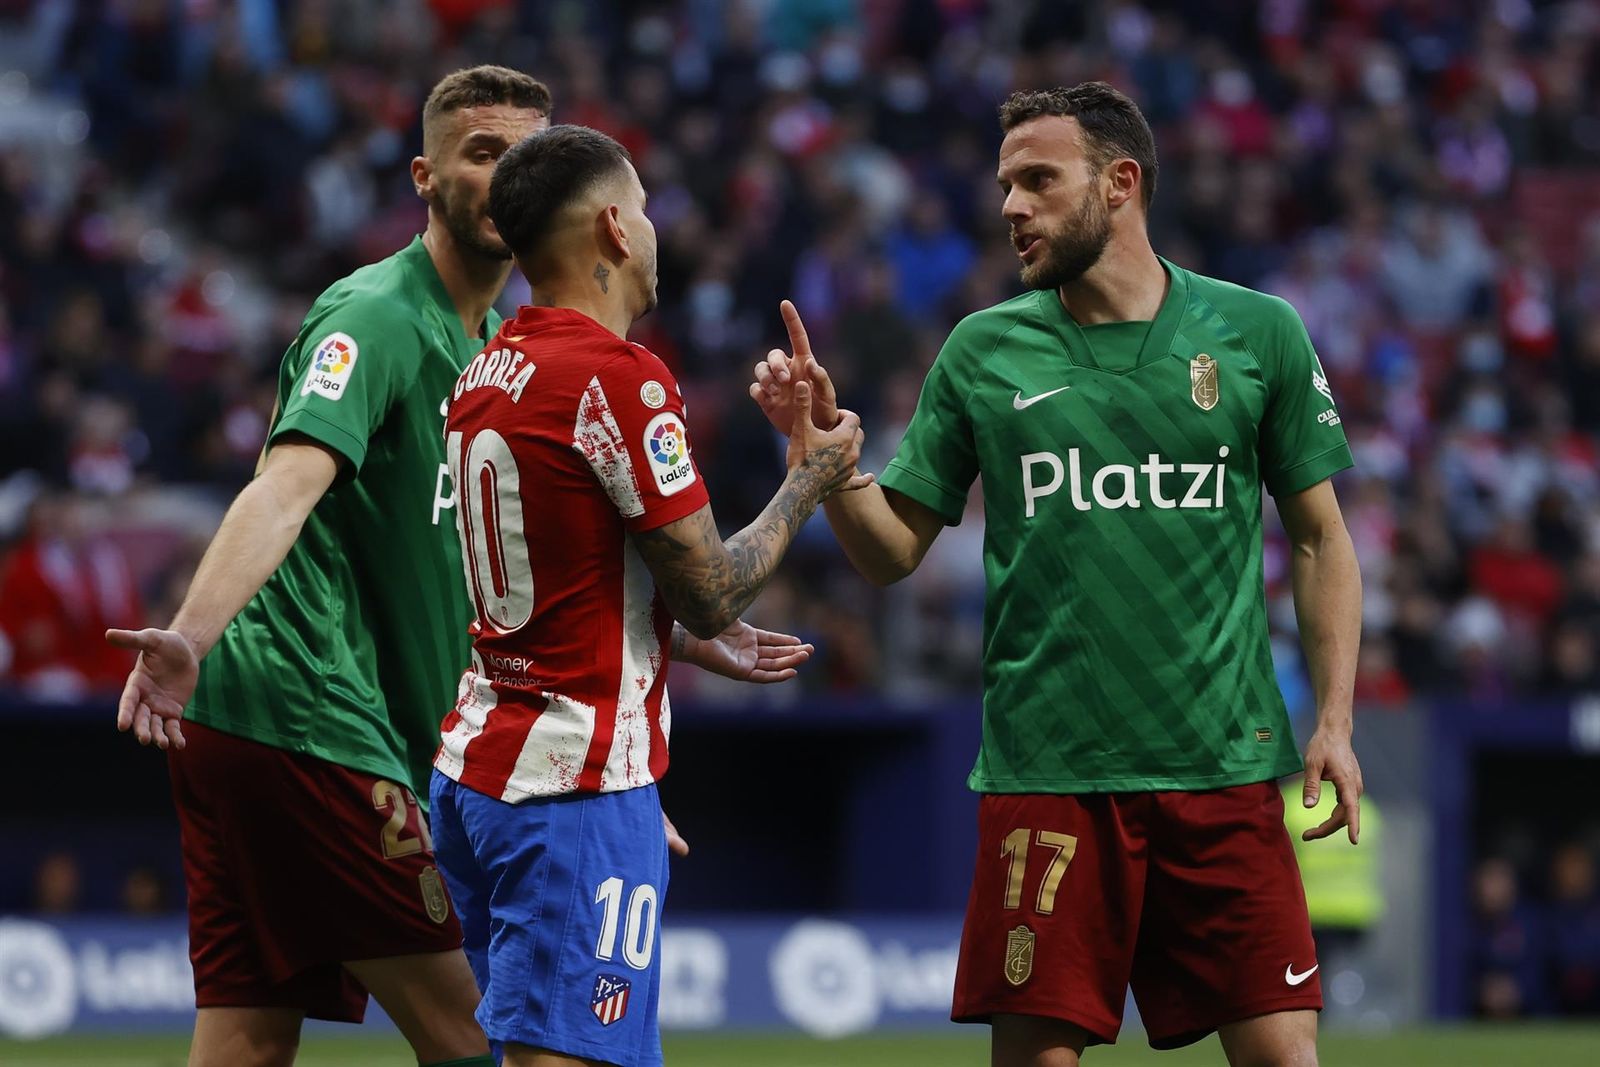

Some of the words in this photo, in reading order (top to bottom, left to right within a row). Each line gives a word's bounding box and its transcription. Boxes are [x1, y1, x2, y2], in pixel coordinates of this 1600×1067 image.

[307, 375, 341, 392] LLiga
[453, 348, 537, 404] CORREA
[660, 462, 691, 485] LaLiga
[1020, 444, 1230, 518] Platzi
[445, 427, 534, 634] 10
[1000, 828, 1078, 915] 17
[595, 876, 657, 970] 10
